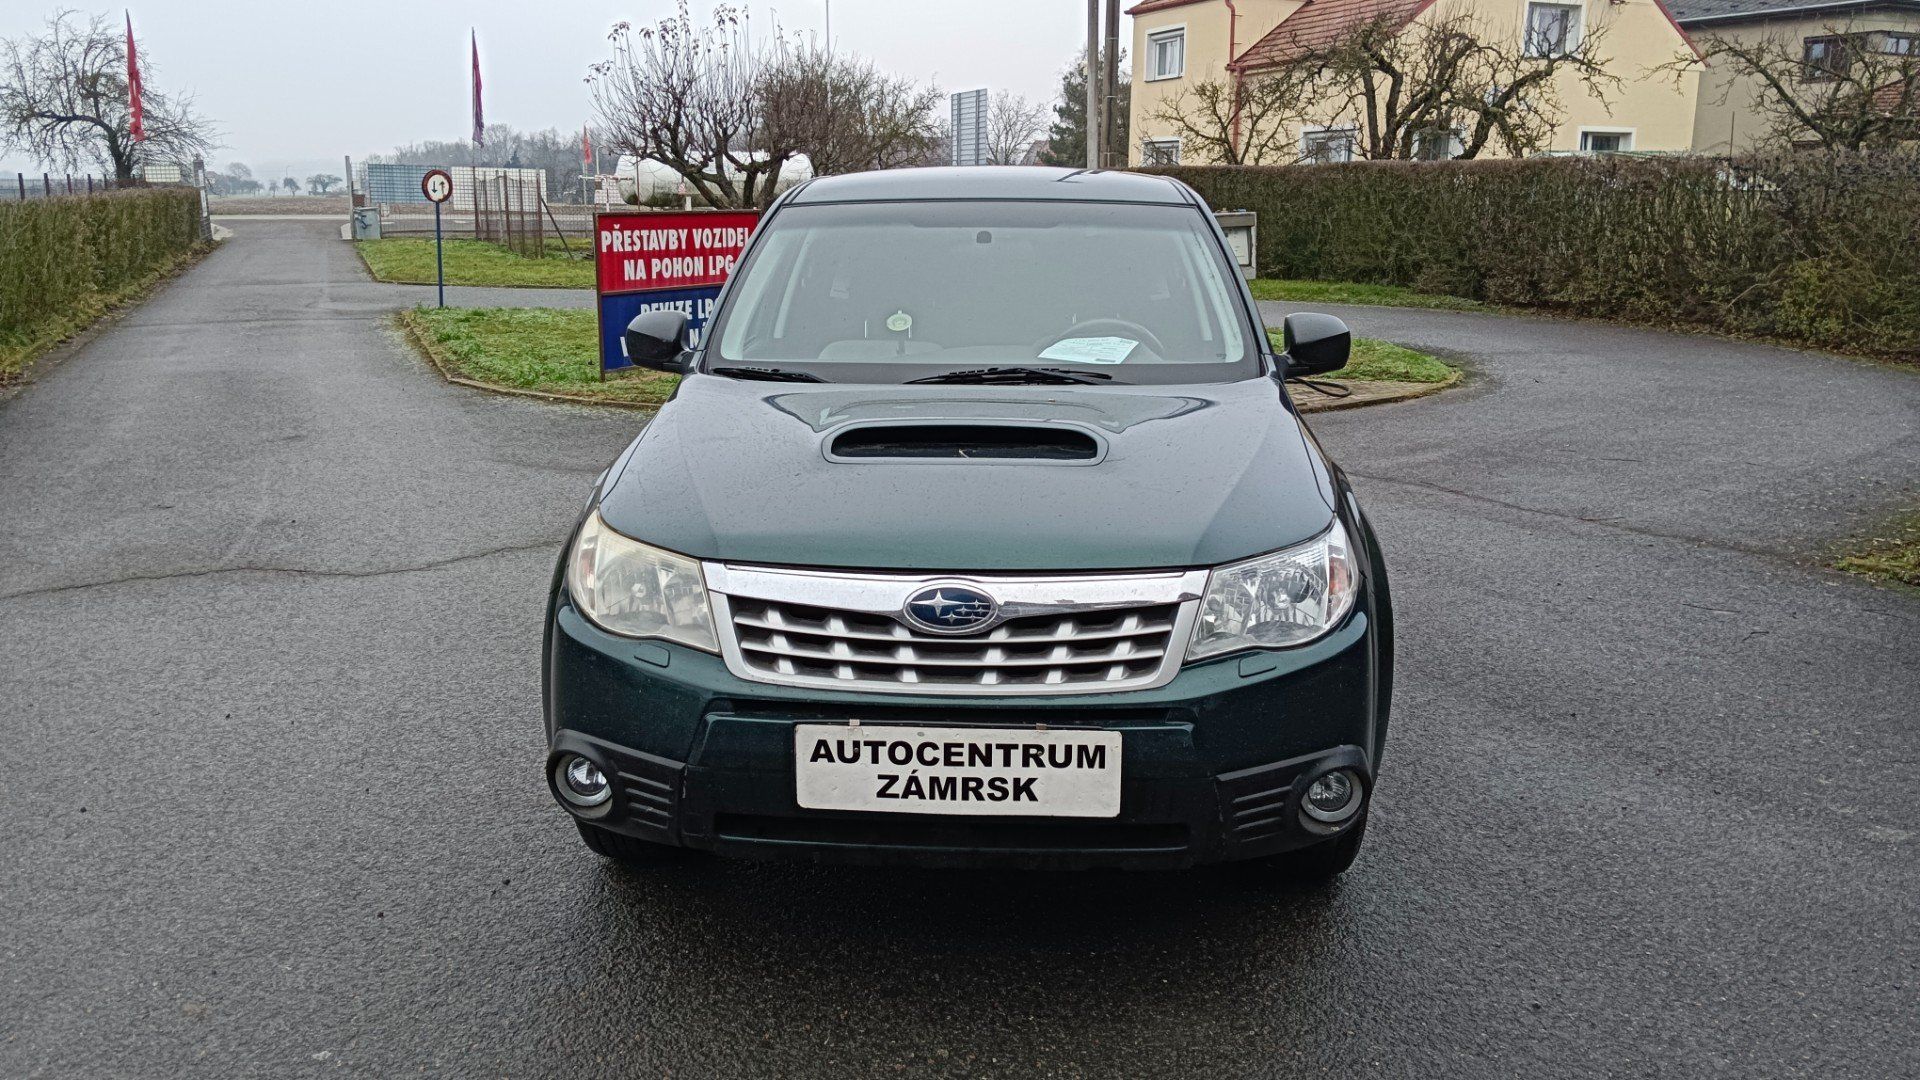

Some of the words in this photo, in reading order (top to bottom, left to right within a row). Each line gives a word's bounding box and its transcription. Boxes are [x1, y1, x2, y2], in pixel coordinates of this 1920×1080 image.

[601, 224, 688, 252] PŘESTAVBY
[624, 259, 647, 281] NA
[651, 256, 704, 279] POHON
[708, 254, 735, 276] LPG
[698, 298, 718, 319] LP
[809, 739, 1106, 769] AUTOCENTRUM
[876, 769, 1039, 802] ZÁMRSK
